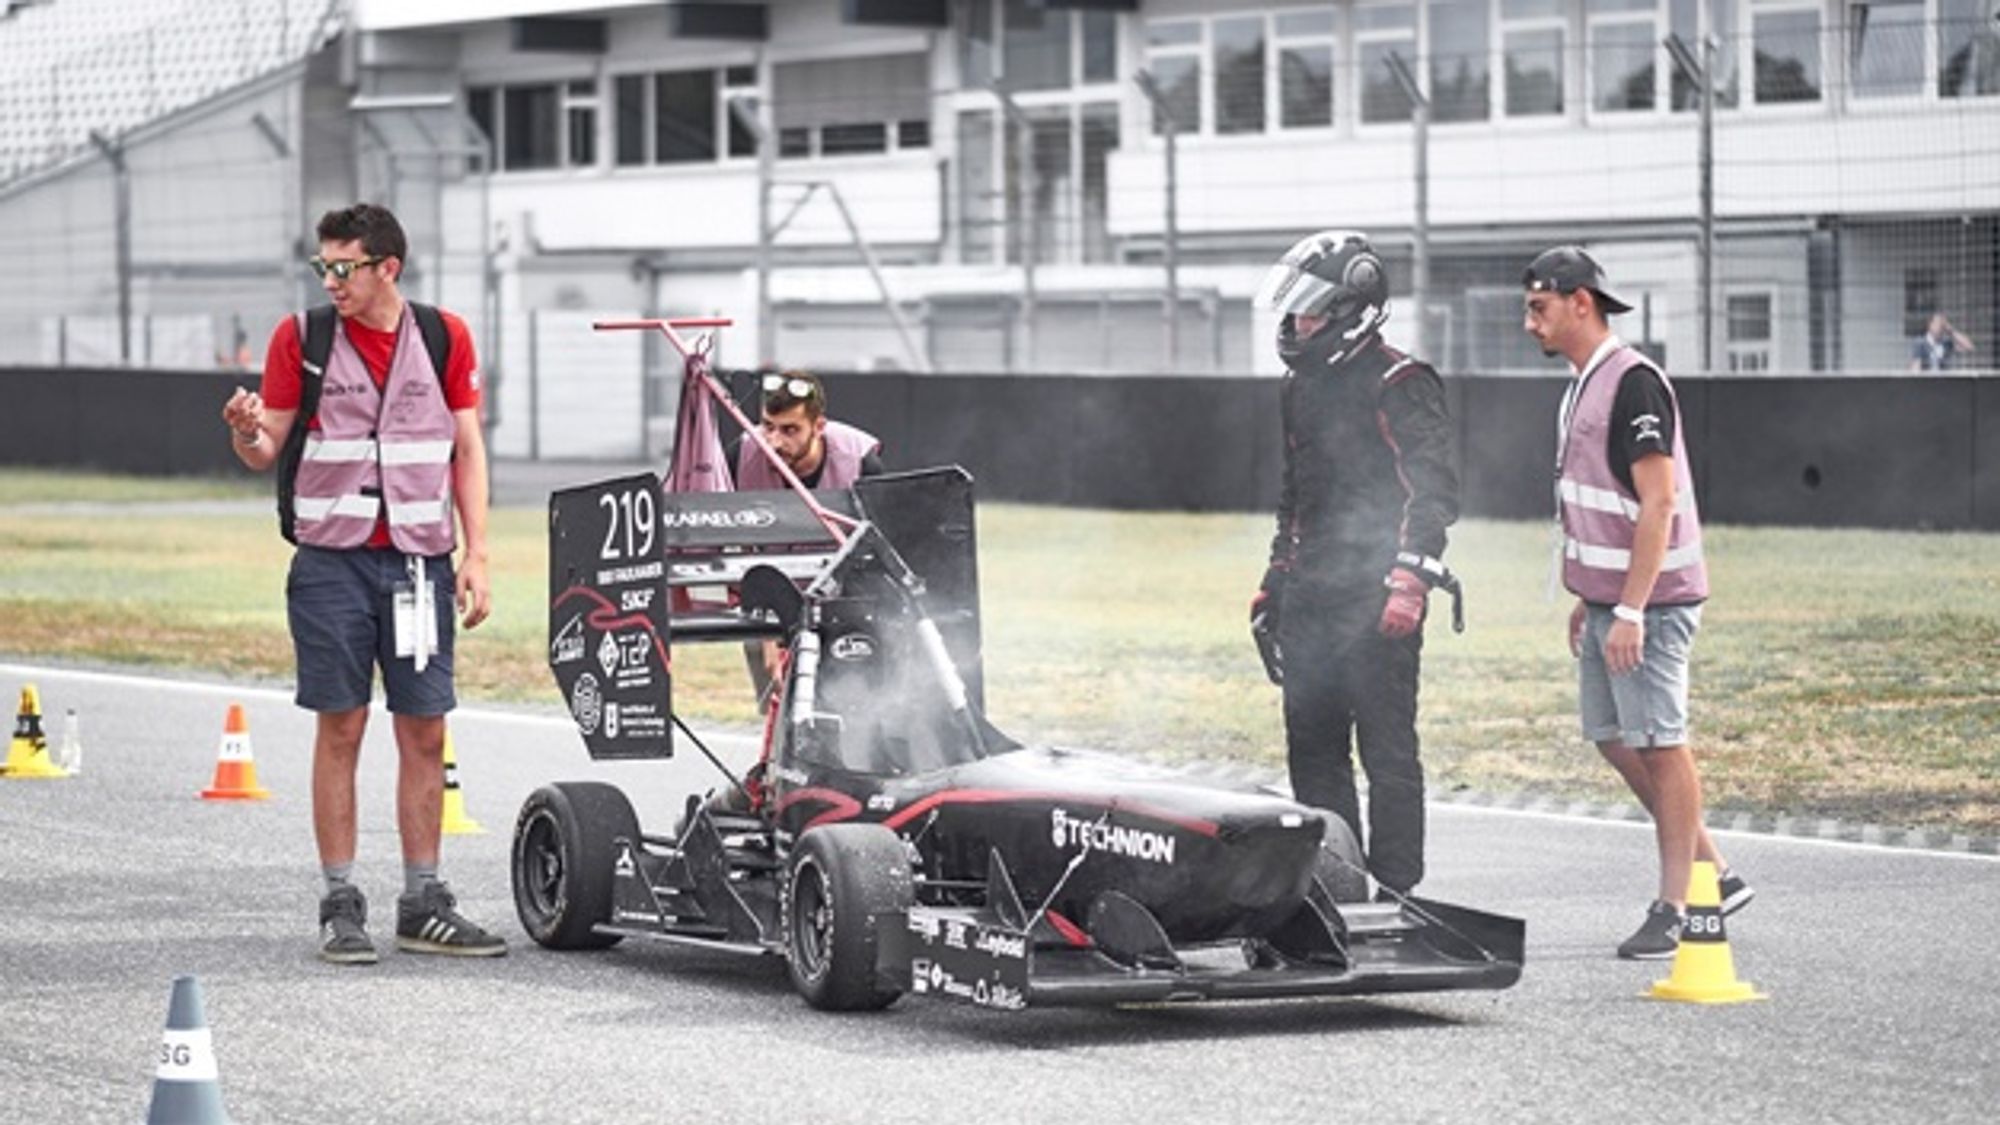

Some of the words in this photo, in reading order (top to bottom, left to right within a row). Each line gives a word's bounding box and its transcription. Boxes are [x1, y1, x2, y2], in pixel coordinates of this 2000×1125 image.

[599, 488, 655, 560] 219
[621, 588, 656, 611] SKF
[1068, 818, 1176, 864] TECHNION
